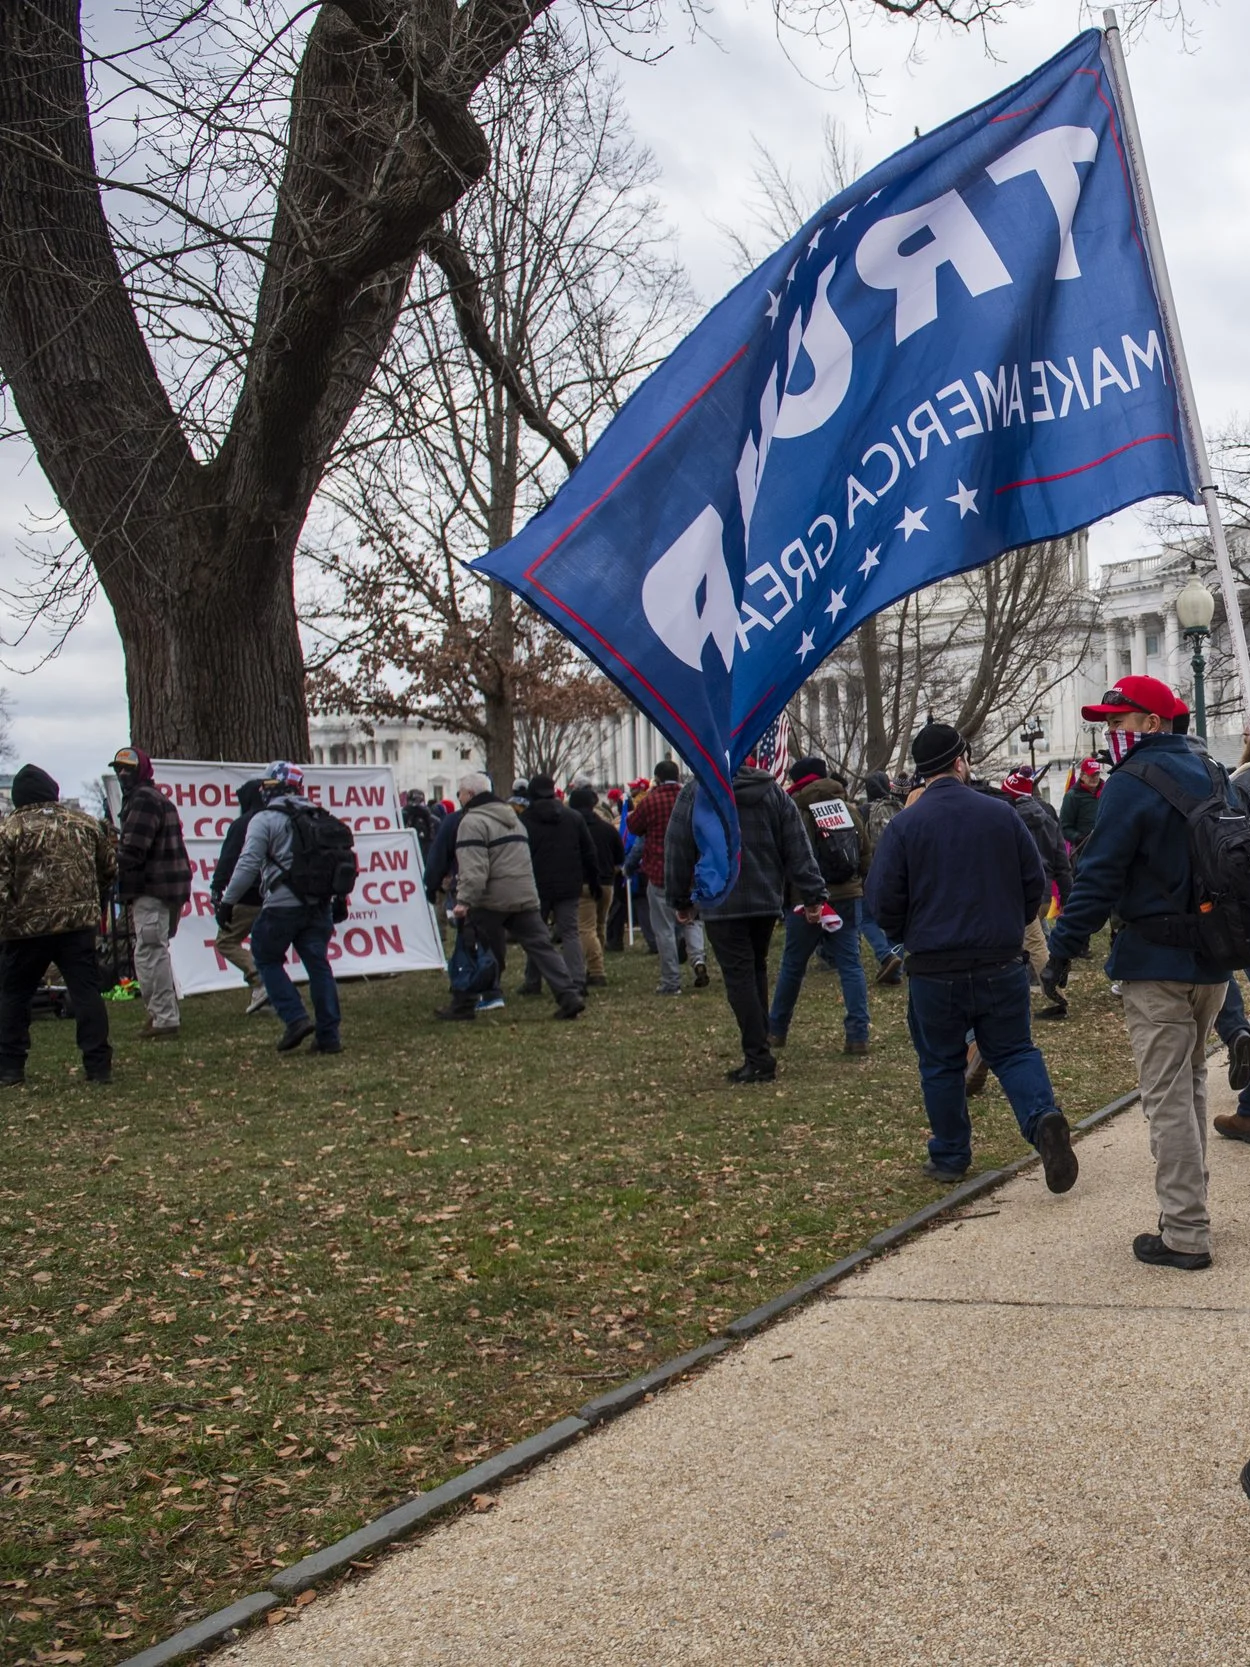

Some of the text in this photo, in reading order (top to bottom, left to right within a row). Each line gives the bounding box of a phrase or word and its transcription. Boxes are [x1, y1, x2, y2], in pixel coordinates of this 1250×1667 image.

[329, 785, 385, 807] LAW
[354, 850, 408, 873] LAW
[362, 880, 416, 905] CCP
[349, 909, 378, 921] ARTY)
